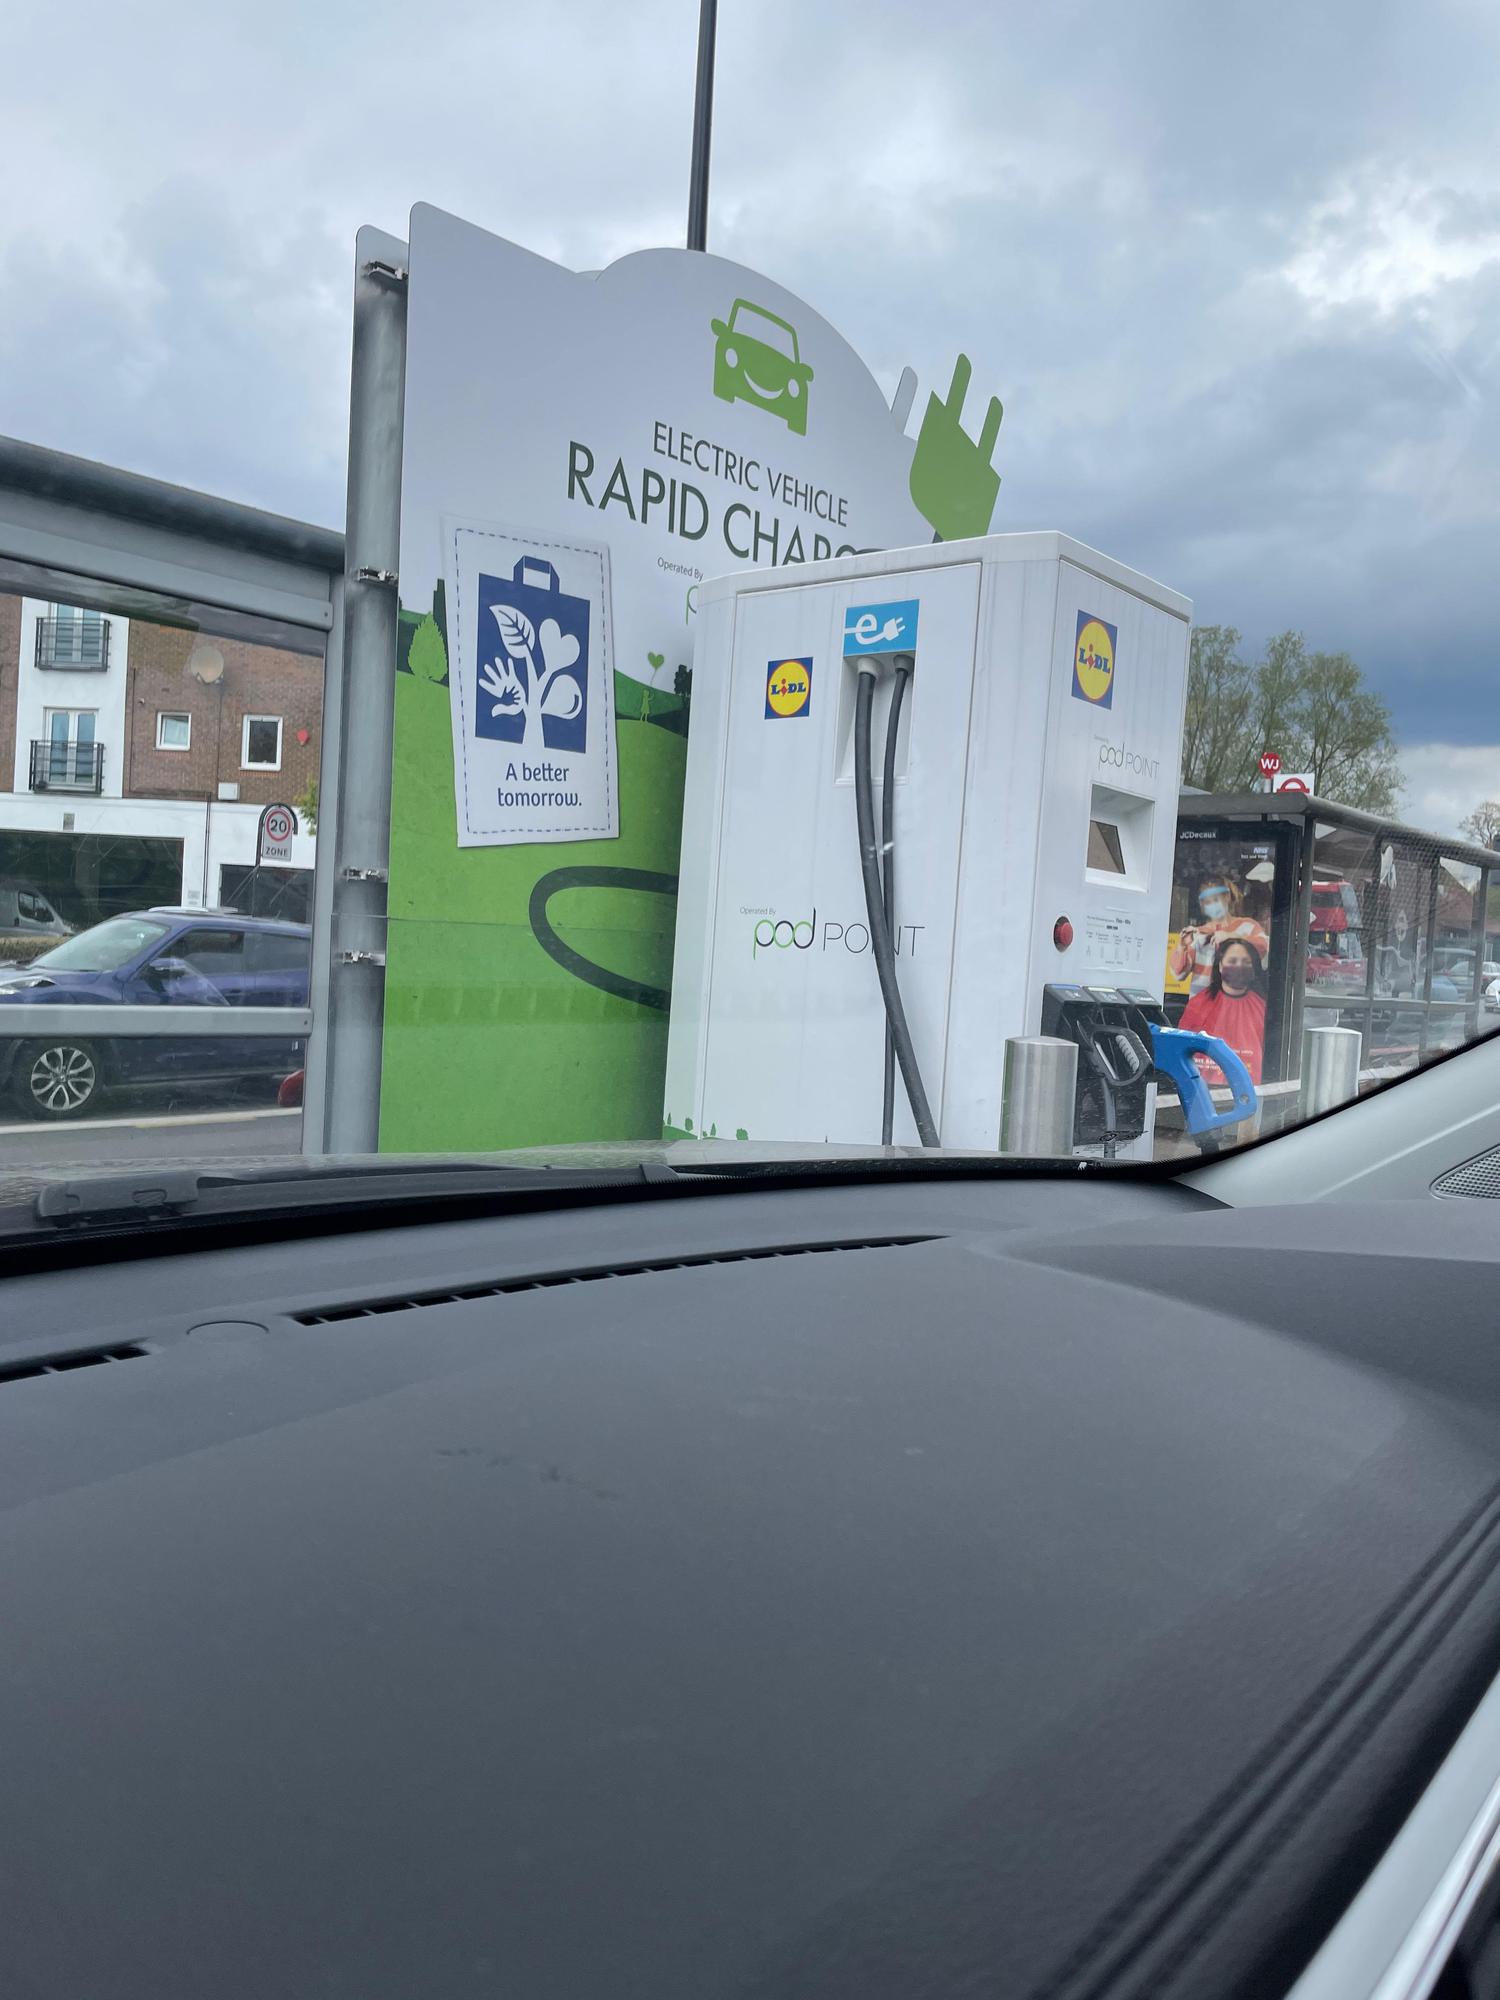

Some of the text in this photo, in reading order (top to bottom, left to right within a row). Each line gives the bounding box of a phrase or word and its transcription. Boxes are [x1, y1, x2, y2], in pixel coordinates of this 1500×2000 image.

[653, 420, 848, 528] ELECTRIC VEHICLE
[567, 440, 709, 541] RAPID
[657, 556, 704, 582] Operated By
[505, 762, 570, 782] A better
[1125, 752, 1160, 780] POINT
[1260, 758, 1280, 770] WJ
[497, 787, 583, 807] tomorrow.
[270, 818, 287, 833] 20
[1179, 831, 1217, 839] JCDecaux
[265, 847, 288, 857] ZONE
[740, 907, 776, 916] Operated By
[753, 906, 926, 961] pod POT
